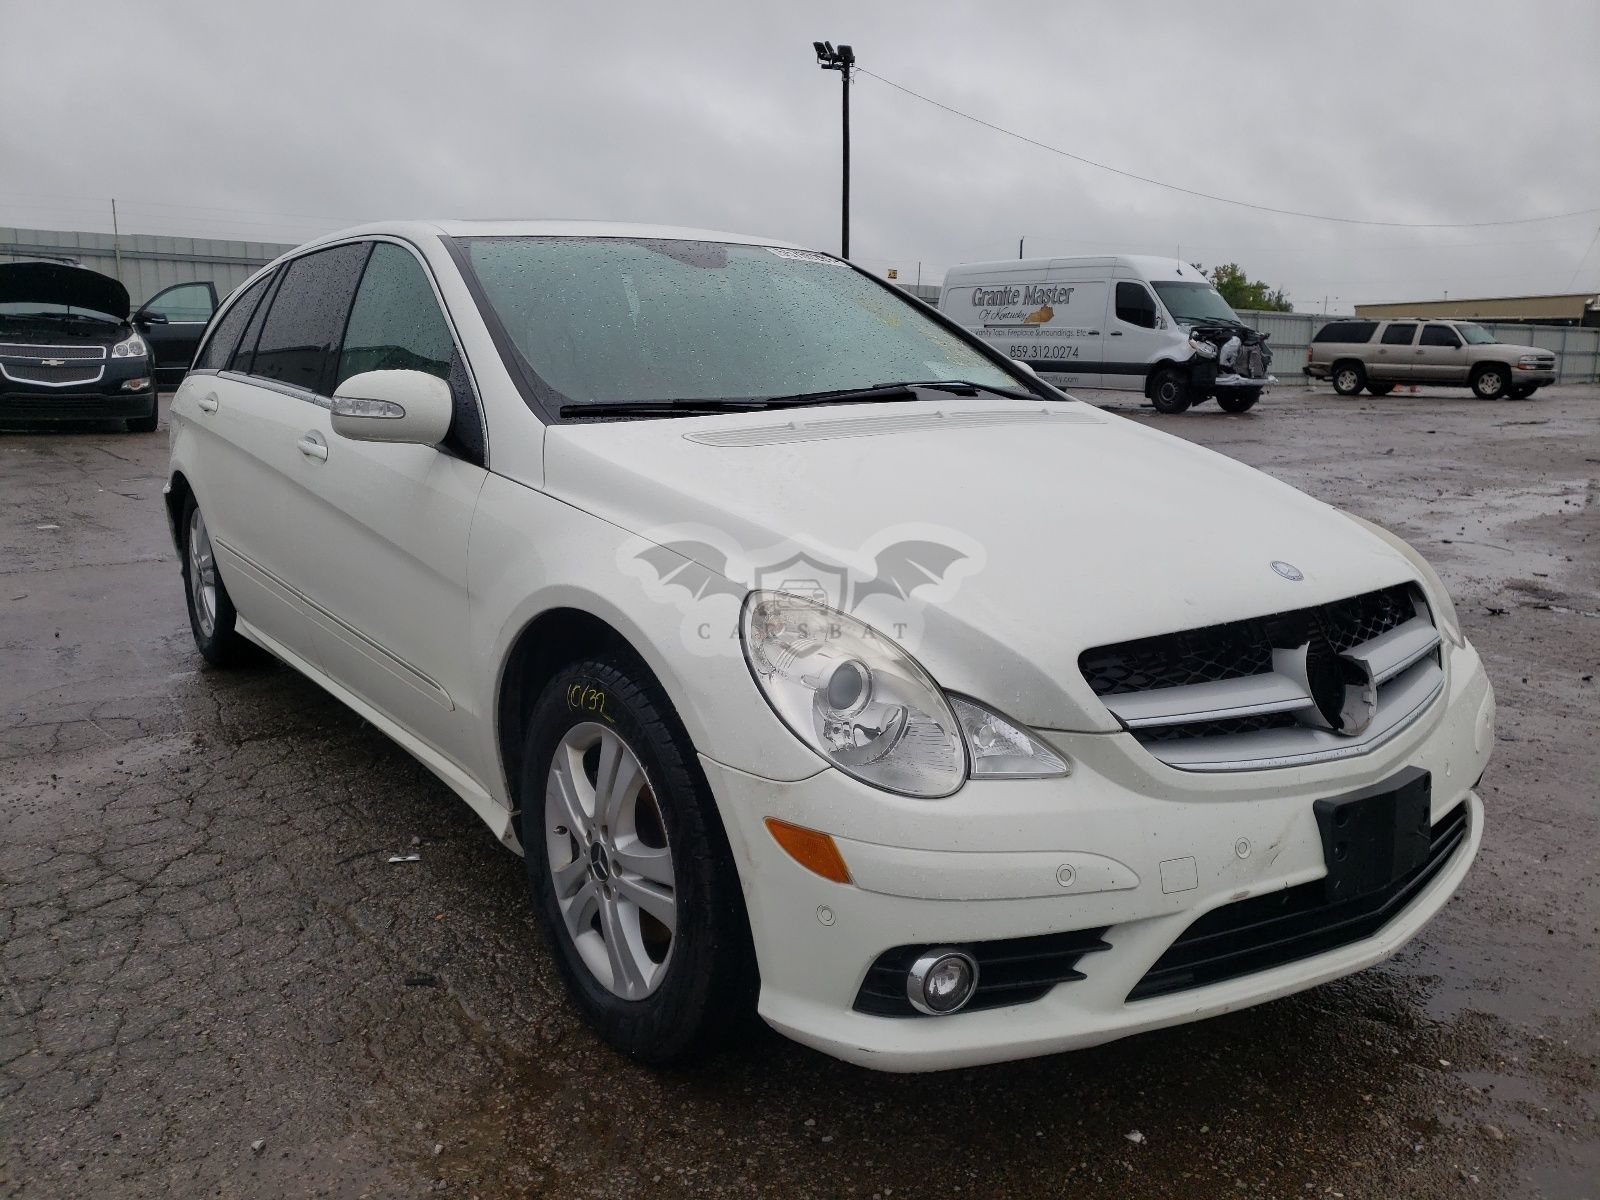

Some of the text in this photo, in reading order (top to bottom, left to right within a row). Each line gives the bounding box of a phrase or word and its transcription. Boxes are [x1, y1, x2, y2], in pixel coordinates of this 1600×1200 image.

[972, 285, 1075, 306] Granite Master
[979, 307, 1027, 321] Of Kentucky
[1007, 328, 1033, 338] Fireplace
[1010, 345, 1079, 359] 859.312.0274
